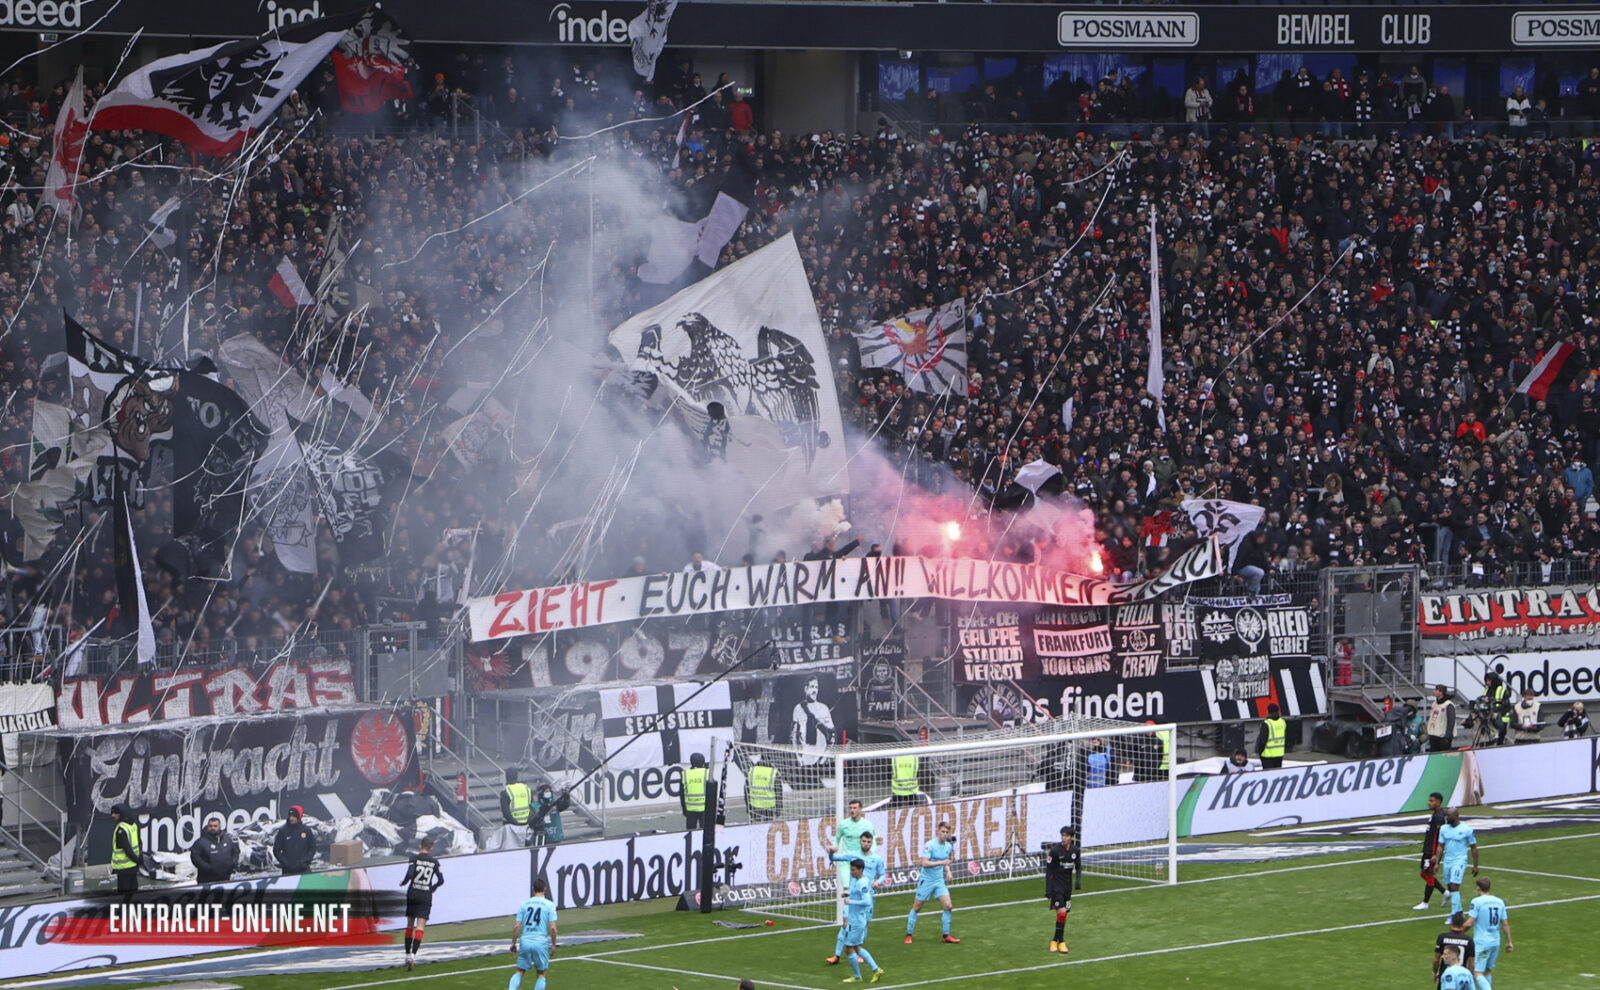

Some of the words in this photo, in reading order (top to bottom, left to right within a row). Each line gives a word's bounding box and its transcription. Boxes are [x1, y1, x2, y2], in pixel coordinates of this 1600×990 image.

[267, 0, 326, 31] ind
[1072, 19, 1186, 39] POSSMANN
[1277, 14, 1355, 45] BEMBEL
[1381, 14, 1431, 45] CLUB
[488, 579, 618, 640] ZIEHT
[639, 567, 731, 617] EUCH
[746, 557, 837, 606] WARM
[921, 557, 1098, 604] WILLKOMMEN
[1116, 603, 1154, 626] FULDA
[1267, 609, 1309, 637] RIED
[771, 623, 846, 641] ULTRAS
[960, 626, 1021, 646] GRUPPE
[1121, 634, 1128, 648] 3
[1149, 633, 1156, 647] 6
[1494, 622, 1528, 639] ewig
[1537, 621, 1562, 636] dir
[1038, 630, 1110, 652] FRANKFURT
[1171, 639, 1193, 656] 64
[1270, 636, 1310, 655] GEBIET
[521, 632, 712, 687] 1997
[778, 645, 842, 663] NEVER
[1122, 654, 1160, 679] CREW
[1495, 659, 1600, 697] ndee
[56, 658, 358, 729] ULTRAS
[1060, 683, 1164, 720] finden
[1216, 682, 1234, 701] 61
[85, 719, 341, 816] Eintracht
[584, 765, 684, 805] indee
[1208, 756, 1413, 811] Krombacher
[766, 796, 1028, 883] CAS-KORKEN
[414, 865, 434, 885] 29
[980, 860, 996, 873] LG
[802, 880, 817, 893] LG
[892, 871, 907, 884] LG
[728, 889, 757, 902] OLED
[756, 887, 772, 899] TV
[525, 906, 541, 927] 24
[1488, 906, 1499, 927] 13
